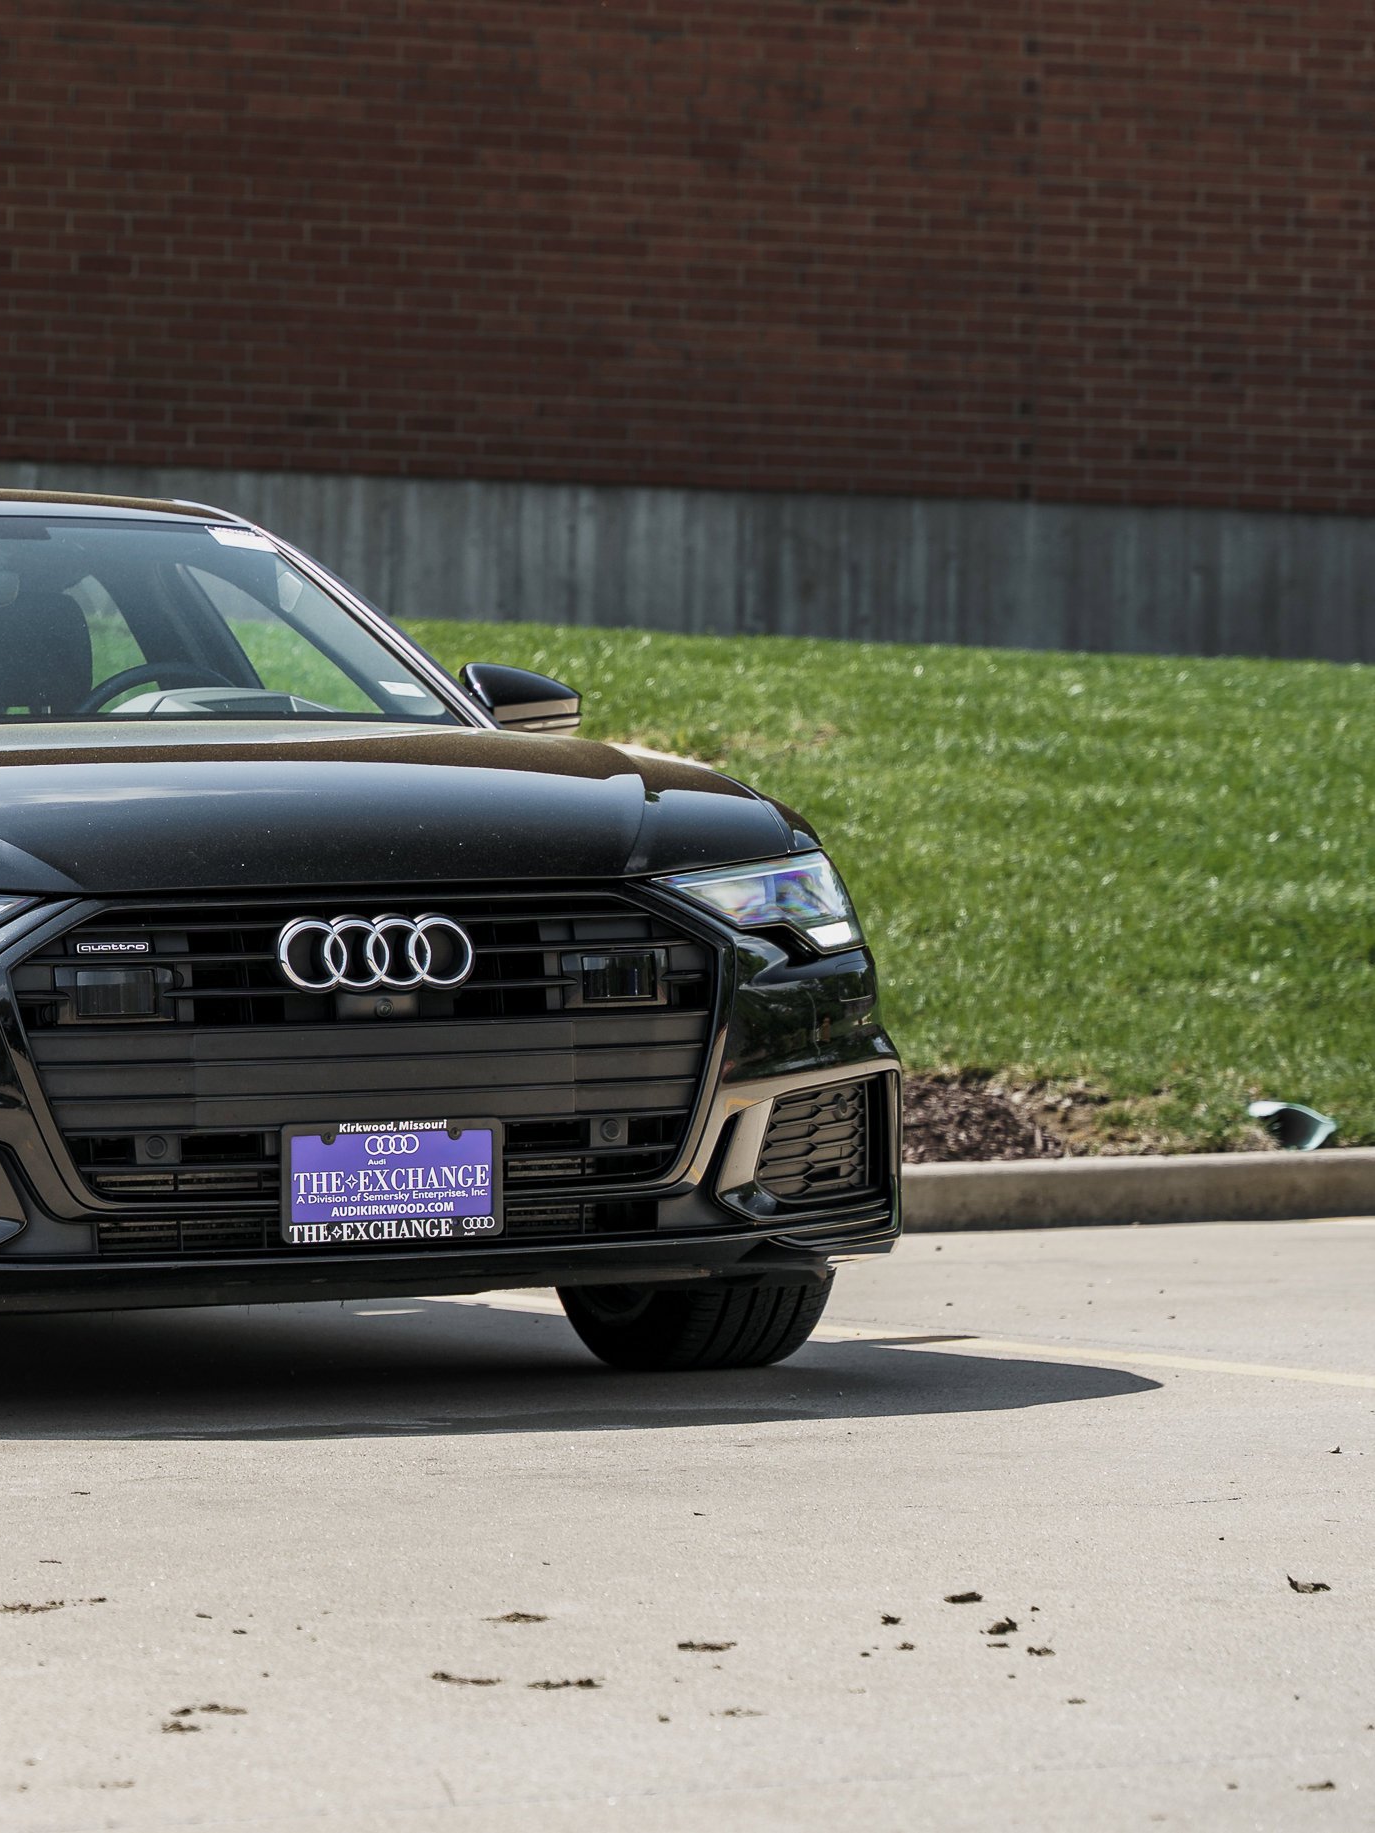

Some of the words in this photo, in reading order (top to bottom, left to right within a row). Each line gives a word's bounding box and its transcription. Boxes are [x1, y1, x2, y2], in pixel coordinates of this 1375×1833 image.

[80, 943, 146, 953] quattro
[339, 1122, 396, 1133] Kirkwood,
[398, 1119, 447, 1131] Missouri
[293, 1171, 345, 1195] THE
[357, 1164, 490, 1193] EXCHANGE
[296, 1195, 305, 1205] A
[308, 1193, 348, 1204] Division
[350, 1193, 362, 1202] of
[363, 1191, 410, 1202] Semersky
[412, 1188, 469, 1200] Enterprises,
[471, 1187, 488, 1197] Inc.
[331, 1201, 454, 1217] AUDIKIRKWOOD.COM
[289, 1223, 332, 1244] THE
[341, 1218, 453, 1241] EXCHANGE
